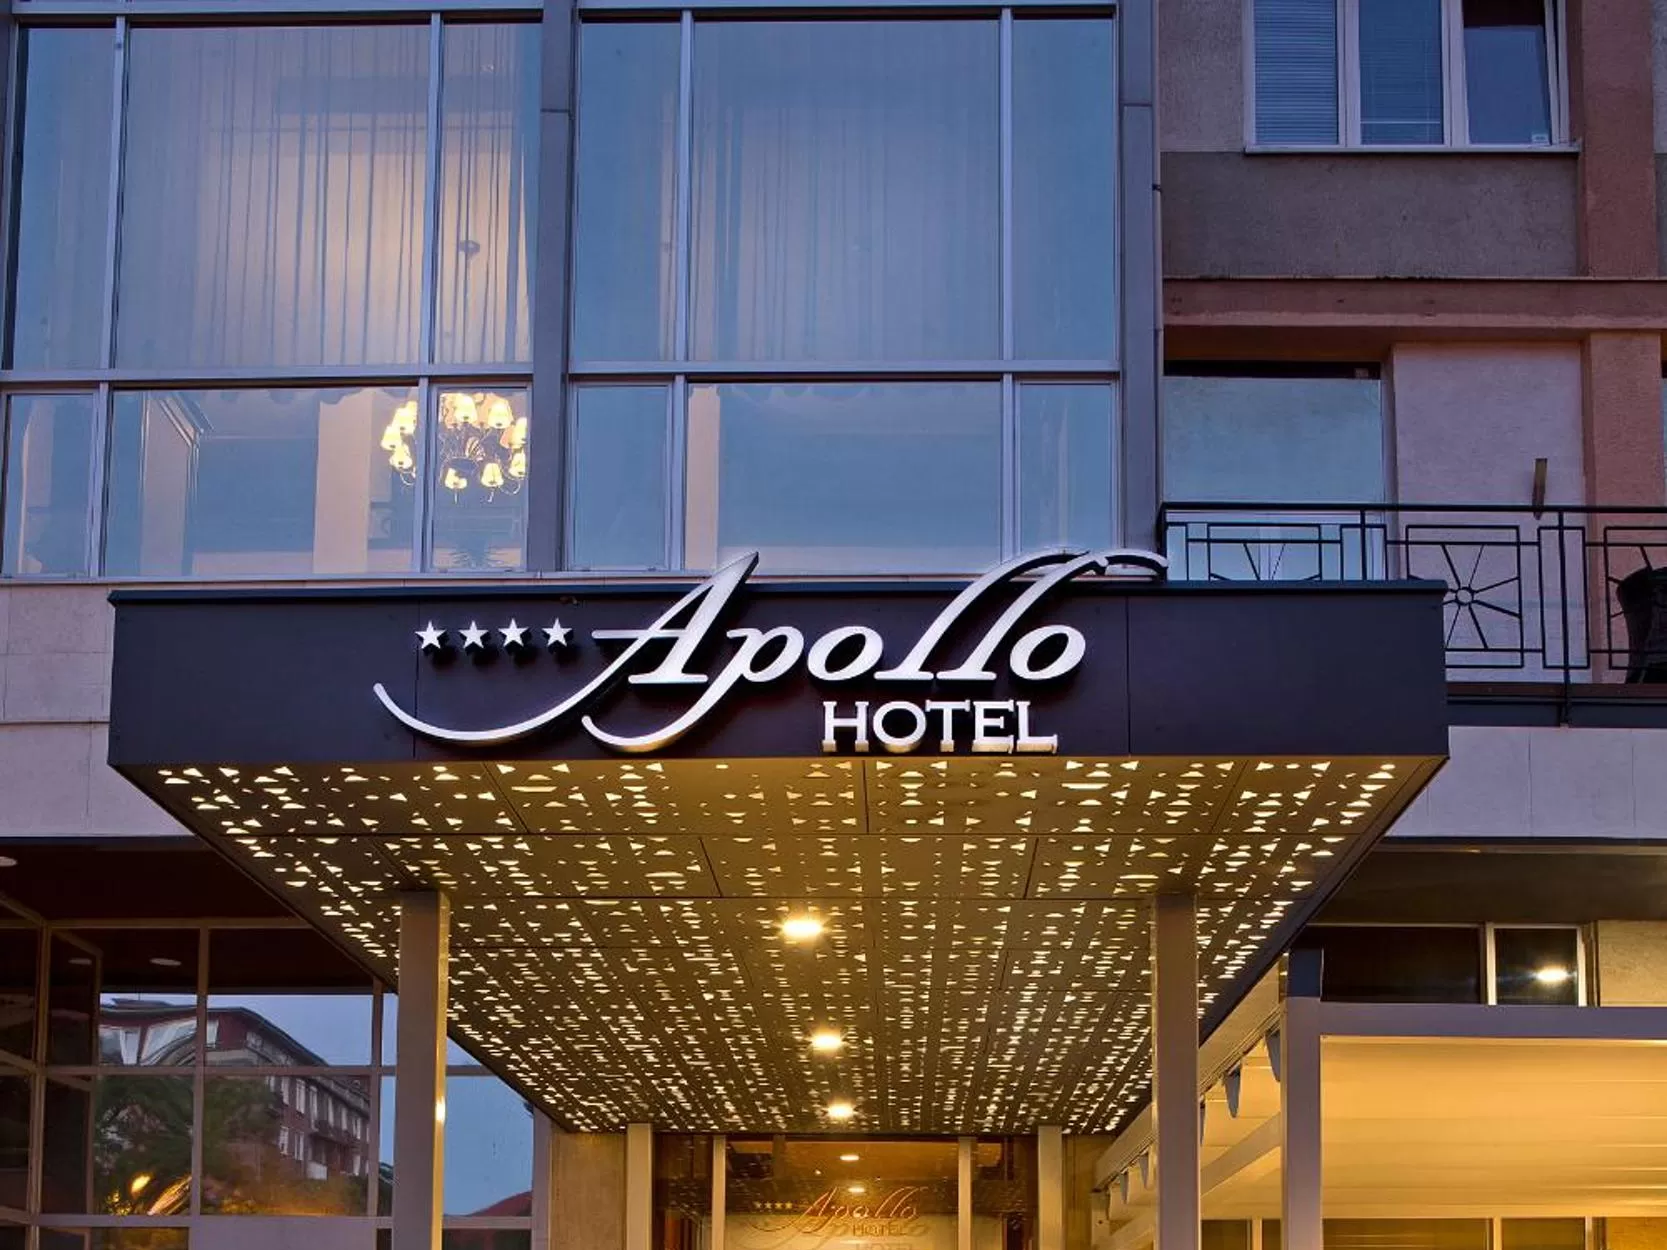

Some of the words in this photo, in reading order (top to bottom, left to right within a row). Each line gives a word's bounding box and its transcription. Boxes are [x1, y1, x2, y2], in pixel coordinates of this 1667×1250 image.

[373, 550, 1168, 752] Apollo
[821, 699, 1058, 754] HOTEL
[748, 1186, 929, 1234] Apollo
[852, 1222, 906, 1238] HOTEL
